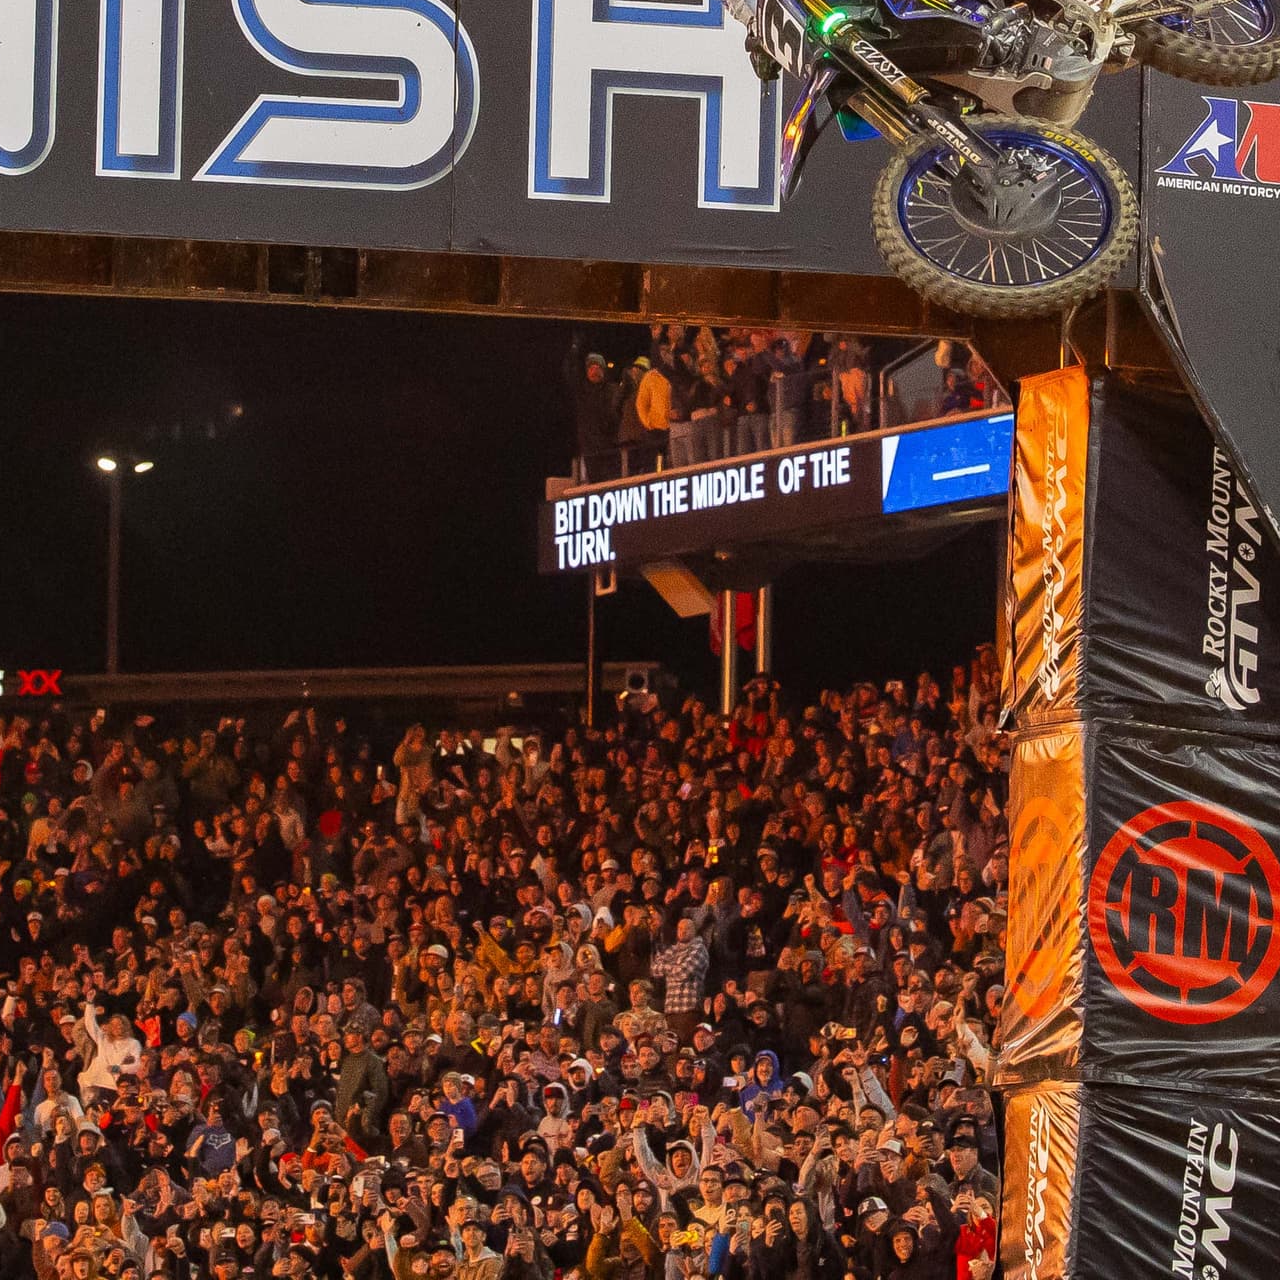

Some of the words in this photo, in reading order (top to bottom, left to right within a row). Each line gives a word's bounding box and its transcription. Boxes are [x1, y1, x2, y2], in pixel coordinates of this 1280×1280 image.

[852, 39, 907, 85] KYB
[927, 118, 984, 165] DUNLOP
[1042, 130, 1097, 163] DUNLOP
[1156, 176, 1222, 193] AMERICAN
[554, 494, 586, 536] BIT
[587, 487, 647, 530] DOWN
[651, 479, 690, 518] THE
[692, 463, 766, 513] MIDDLE
[777, 456, 809, 494] OF
[809, 447, 850, 488] THE
[1205, 445, 1233, 562] MOUNT
[554, 528, 616, 569] TURN.
[1040, 556, 1055, 653] ROCKY
[1202, 560, 1228, 663] ROCKY
[18, 670, 63, 696] XX
[1125, 862, 1260, 964] RM
[1023, 1104, 1040, 1265] MOUNTAIN
[1171, 1116, 1210, 1280] MOUNTAIN
